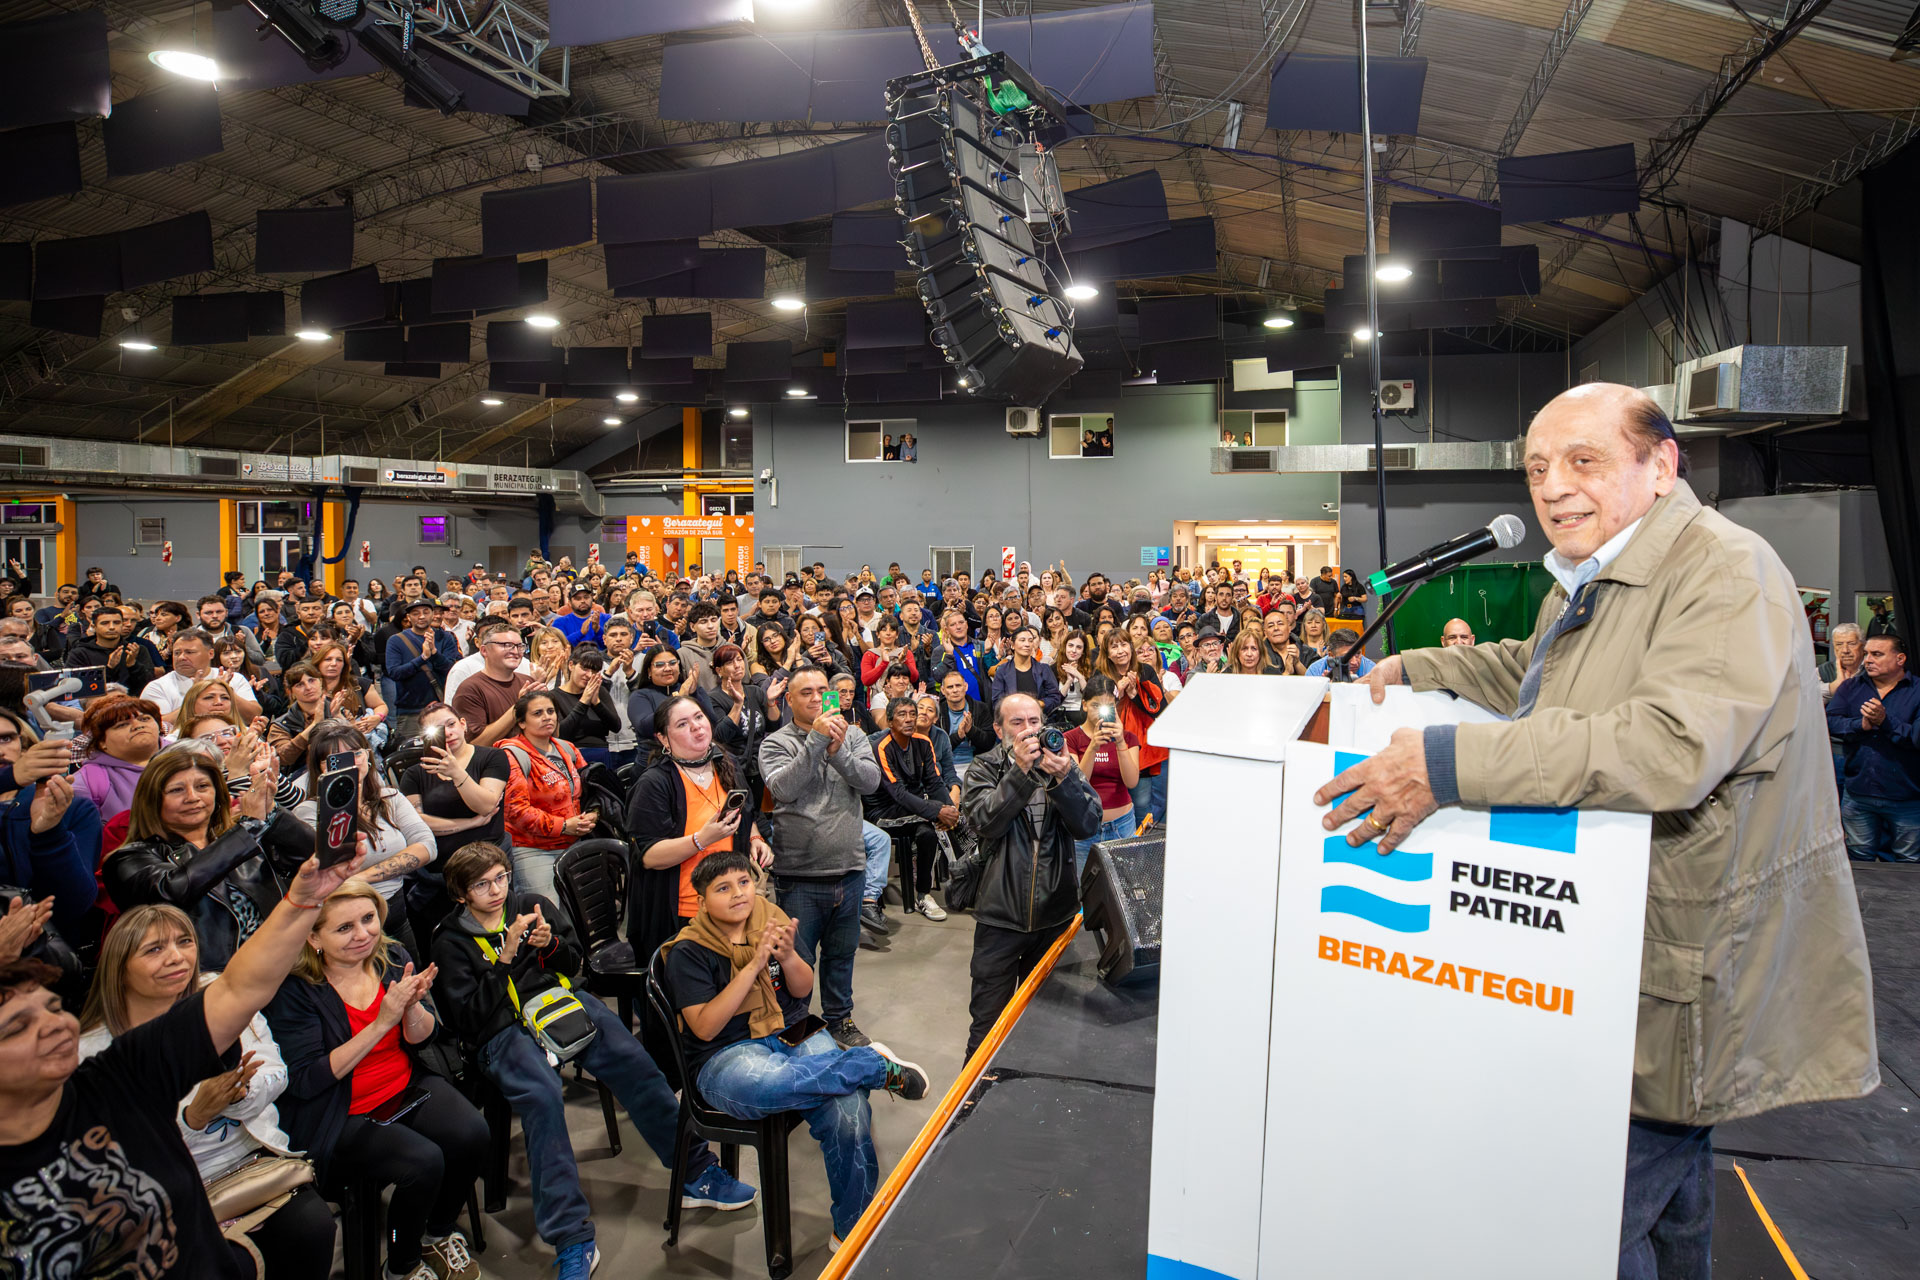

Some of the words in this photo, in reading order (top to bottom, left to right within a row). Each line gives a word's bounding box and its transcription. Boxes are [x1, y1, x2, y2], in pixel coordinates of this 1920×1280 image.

[494, 473, 542, 483] BERAZATEGUI
[494, 482, 542, 490] MUNICIPALIDAD
[663, 517, 723, 530] Berazategui
[1451, 861, 1580, 905] FUERZA
[1449, 890, 1566, 934] PATRIA
[1318, 935, 1574, 1016] BERAZATEGUI
